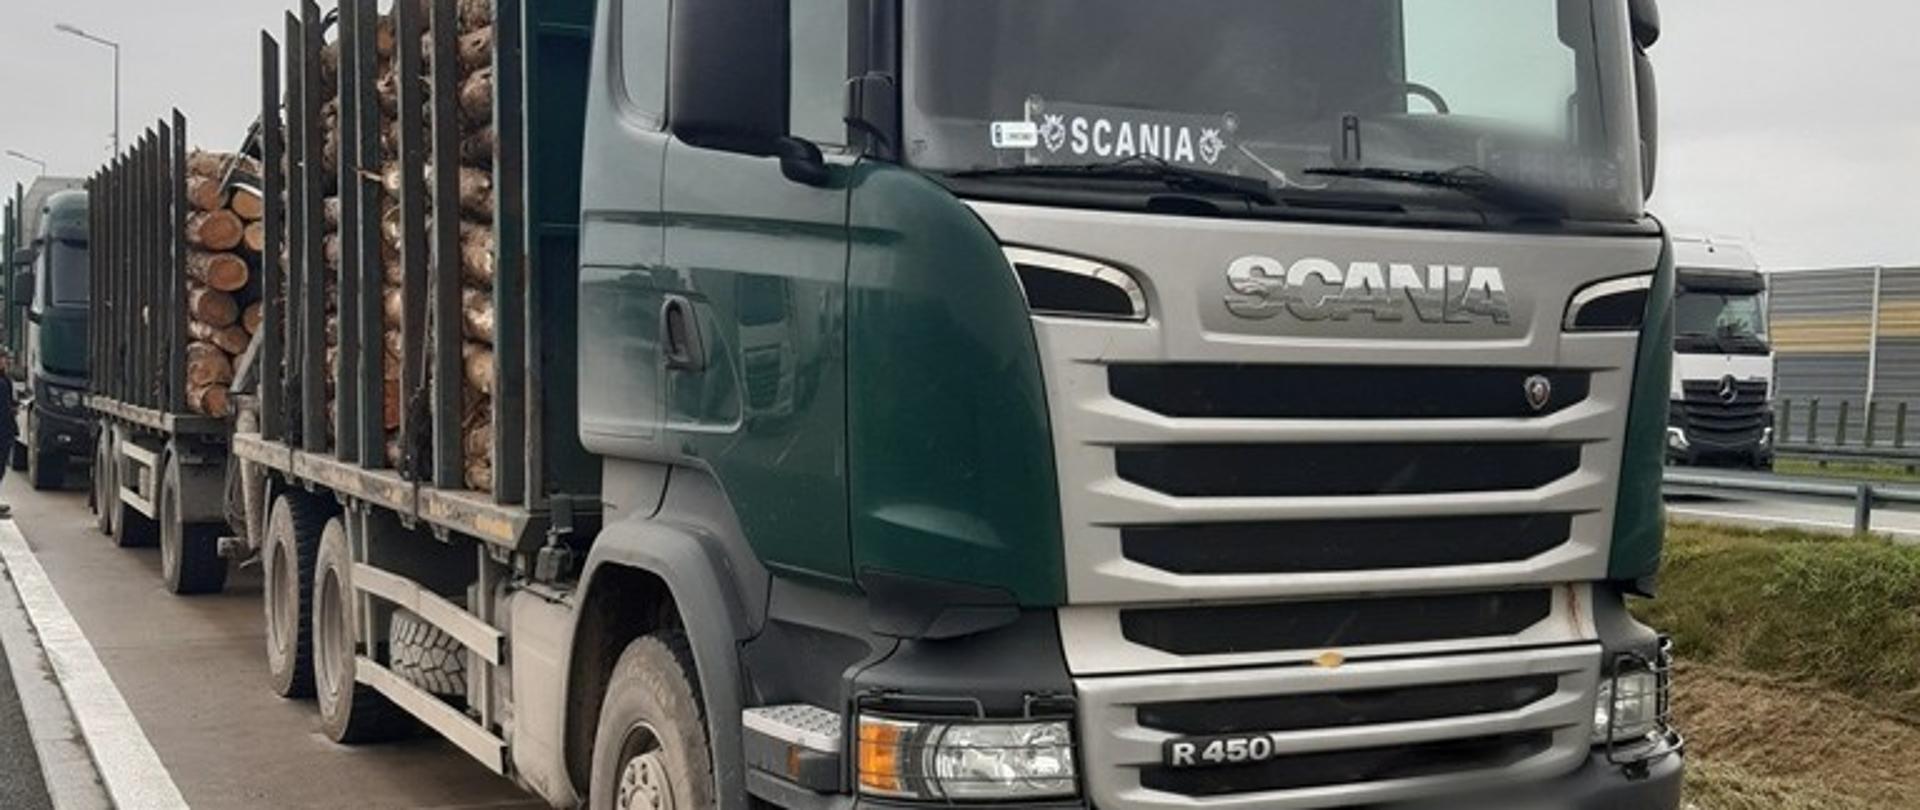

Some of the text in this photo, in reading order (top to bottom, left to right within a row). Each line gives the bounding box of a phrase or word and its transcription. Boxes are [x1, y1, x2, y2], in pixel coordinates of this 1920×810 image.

[1070, 116, 1195, 163] SCANIA
[1223, 254, 1512, 325] SCANIA
[1172, 737, 1272, 766] R 450
